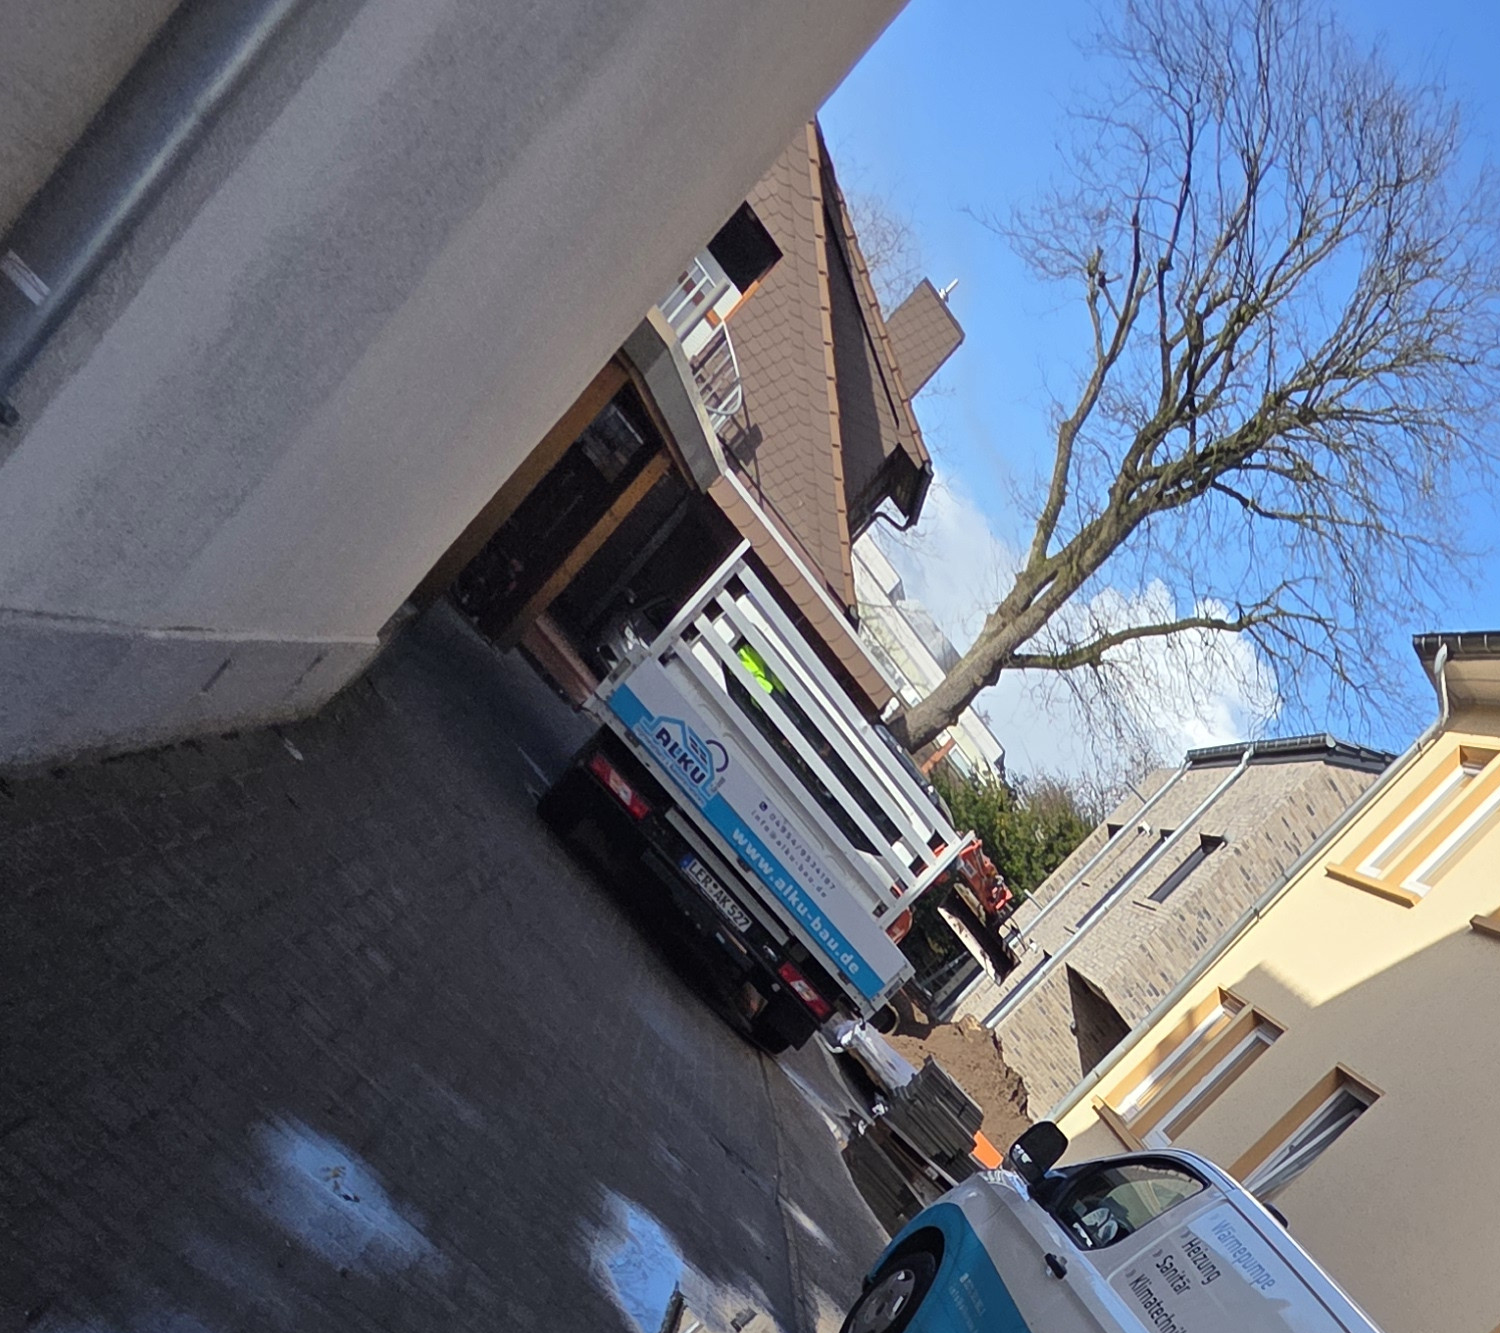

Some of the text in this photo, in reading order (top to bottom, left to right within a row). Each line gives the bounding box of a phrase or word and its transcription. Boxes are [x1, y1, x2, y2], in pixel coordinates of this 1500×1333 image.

[655, 727, 706, 784] ALKU
[688, 858, 750, 928] LER AK 527
[732, 828, 860, 975] www.alku-bau.de
[1155, 1254, 1192, 1295] Sanitär
[1181, 1237, 1222, 1286] Heizung
[1211, 1219, 1276, 1291] Wärmepumpe
